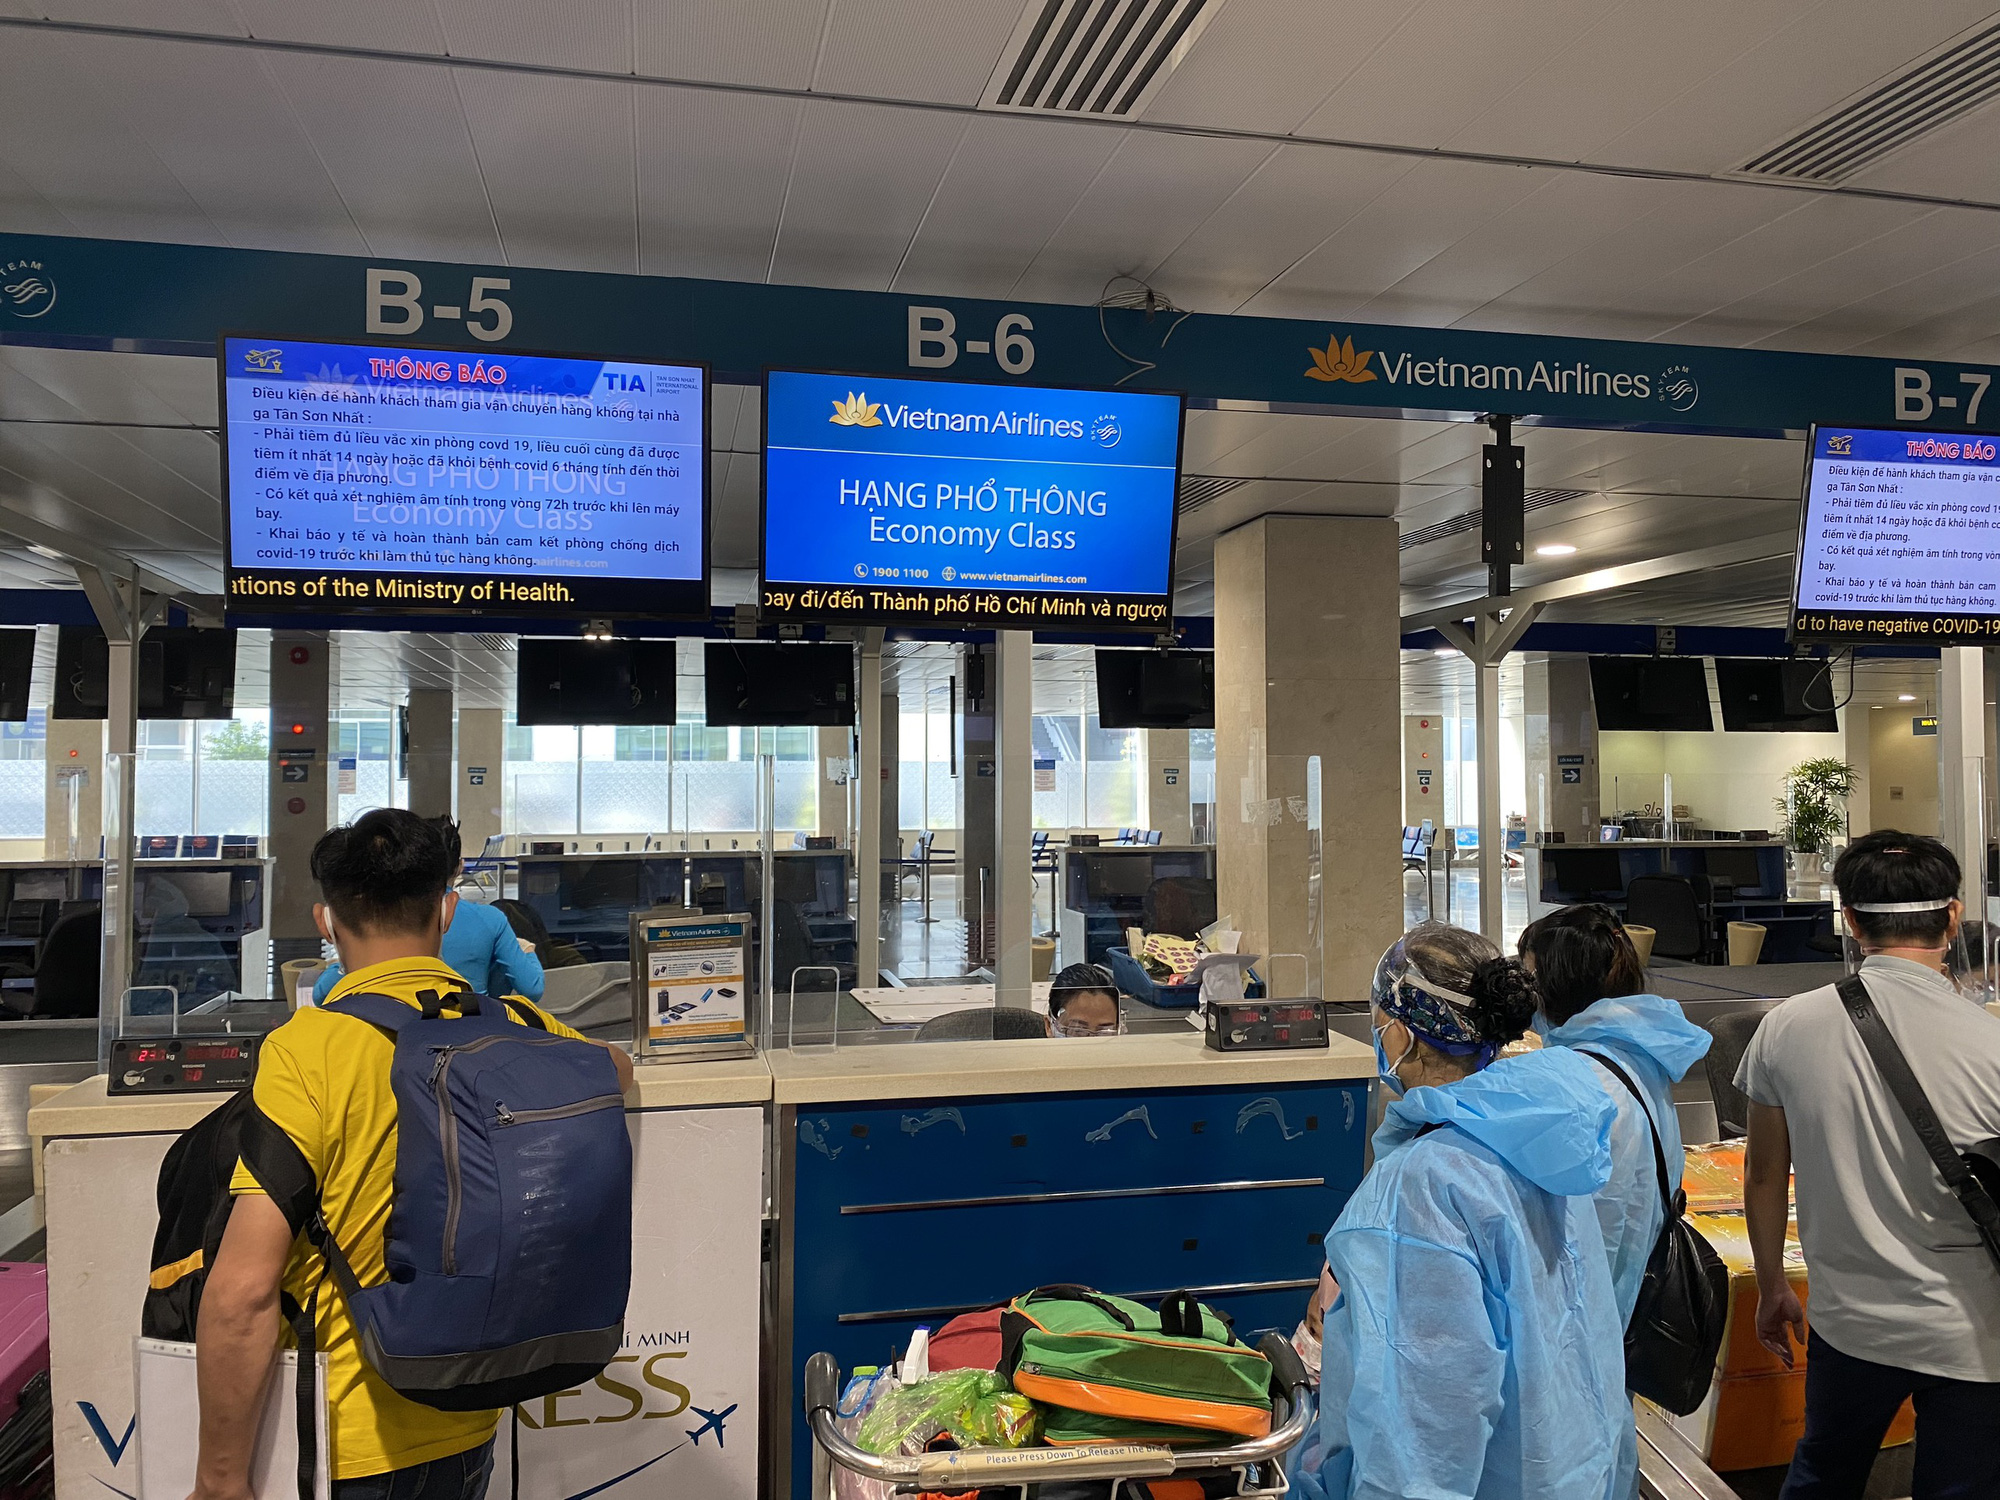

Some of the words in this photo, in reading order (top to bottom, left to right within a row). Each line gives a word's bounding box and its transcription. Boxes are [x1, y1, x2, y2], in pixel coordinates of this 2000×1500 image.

[0, 260, 42, 277] TEAM
[365, 267, 513, 342] B-5
[907, 305, 1035, 375] B-6
[368, 356, 452, 382] THÔNG
[457, 360, 507, 385] BÁO
[602, 373, 646, 393] TIA
[1377, 351, 1522, 391] Vietnam
[1526, 360, 1650, 398] Airlines
[656, 382, 699, 390] INTERNATIONAL
[1657, 365, 1689, 402] SKYTEAM
[1894, 366, 1991, 424] B-7
[251, 385, 283, 400] Điều
[287, 387, 317, 403] kiện
[320, 389, 339, 403] để
[342, 391, 376, 404] hành
[379, 392, 420, 407] khách
[423, 394, 457, 409] tham
[460, 397, 481, 412] gia
[484, 398, 508, 413] vận
[511, 400, 557, 416] chuyển
[560, 401, 592, 419] hàng
[595, 405, 634, 421] không
[637, 408, 653, 422] tại
[657, 409, 679, 422] nhà
[252, 409, 270, 421] ga
[272, 407, 298, 420] Tân
[301, 409, 328, 422] Sơn
[331, 410, 364, 424] Nhất
[883, 403, 989, 433] Vietnam
[990, 410, 1084, 438] Airlines
[263, 426, 294, 440] Phải
[297, 428, 329, 442] tiêm
[332, 429, 351, 443] đủ
[355, 430, 379, 444] liều
[383, 432, 407, 446] vắc
[410, 434, 430, 447] xin
[434, 435, 475, 452] phòng
[478, 438, 509, 450] covd
[513, 439, 533, 453] 19,
[536, 439, 560, 453] liều
[563, 441, 590, 454] cuối
[593, 443, 625, 459] cùng
[627, 445, 644, 458] đã
[647, 446, 680, 461] được
[1905, 438, 1960, 459] THÔNG
[1962, 441, 1996, 461] BÁO
[253, 446, 284, 459] tiêm
[288, 447, 298, 461] ít
[301, 448, 332, 462] nhất
[335, 451, 352, 462] 14
[355, 451, 388, 467] ngày
[391, 452, 424, 468] hoặc
[427, 454, 444, 467] đã
[447, 454, 476, 468] khỏi
[479, 457, 511, 471] bệnh
[514, 459, 548, 471] covid
[551, 460, 560, 472] 6
[562, 460, 599, 476] tháng
[601, 462, 626, 475] tính
[628, 463, 653, 476] đến
[655, 465, 679, 478] thời
[254, 466, 289, 480] điểm
[292, 467, 309, 481] về
[312, 469, 334, 484] địa
[337, 469, 392, 487] phương.
[265, 487, 284, 499] Có
[287, 487, 309, 500] kết
[312, 488, 338, 503] quả
[341, 489, 363, 502] xét
[366, 490, 416, 506] nghiệm
[419, 493, 440, 505] âm
[443, 493, 469, 506] tính
[472, 495, 507, 510] trong
[510, 496, 541, 512] vòng
[544, 498, 569, 510] 72h
[572, 499, 607, 513] trước
[609, 500, 628, 513] khi
[631, 501, 650, 513] lên
[653, 503, 680, 517] máy
[839, 478, 926, 512] HẠNG
[936, 478, 998, 512] PHỔ
[1003, 483, 1106, 516] THÔNG
[255, 506, 282, 522] bay.
[269, 526, 299, 539] Khai
[306, 527, 331, 541] báo
[337, 531, 345, 543] y
[351, 528, 366, 542] tế
[371, 529, 387, 542] và
[393, 530, 426, 543] hoàn
[431, 531, 469, 545] thành
[475, 532, 499, 546] bản
[505, 537, 533, 547] cam
[538, 535, 559, 548] kết
[564, 536, 604, 552] phòng
[609, 538, 648, 553] chống
[653, 540, 679, 554] dịch
[870, 515, 1001, 553] Economy
[1007, 521, 1076, 549] Class
[256, 546, 316, 559] covid-19
[319, 548, 356, 560] trước
[358, 549, 380, 561] khi
[382, 550, 406, 562] làm
[410, 550, 432, 562] thủ
[434, 552, 455, 566] tục
[458, 551, 490, 567] hàng
[494, 553, 538, 568] không.
[1818, 559, 1836, 573] bay.
[871, 566, 900, 578] 1900
[902, 567, 929, 579] 1100
[959, 571, 1087, 584] www.vietnamairlines.com
[302, 575, 327, 596] of
[331, 576, 369, 597] the
[375, 578, 465, 604] Ministry
[470, 579, 494, 600] of
[499, 581, 575, 602] Health.
[799, 588, 864, 609] đi/đến
[869, 591, 929, 611] Thành
[933, 592, 971, 616] phố
[974, 593, 1001, 613] Hồ
[1006, 595, 1038, 614] Chí
[1041, 597, 1086, 616] Minh
[1090, 598, 1111, 616] và
[1809, 616, 1825, 631] to
[1828, 614, 1864, 632] have
[1867, 617, 1929, 636] negative
[1932, 617, 2000, 634] COVID-19
[166, 1053, 175, 1061] kg
[239, 1051, 249, 1059] kg
[636, 1330, 689, 1347] MINH
[986, 1454, 1018, 1465] Please
[1019, 1452, 1045, 1462] Press
[1046, 1450, 1074, 1460] Down
[1075, 1449, 1087, 1458] To
[1088, 1446, 1125, 1456] Release
[1127, 1445, 1144, 1454] The
